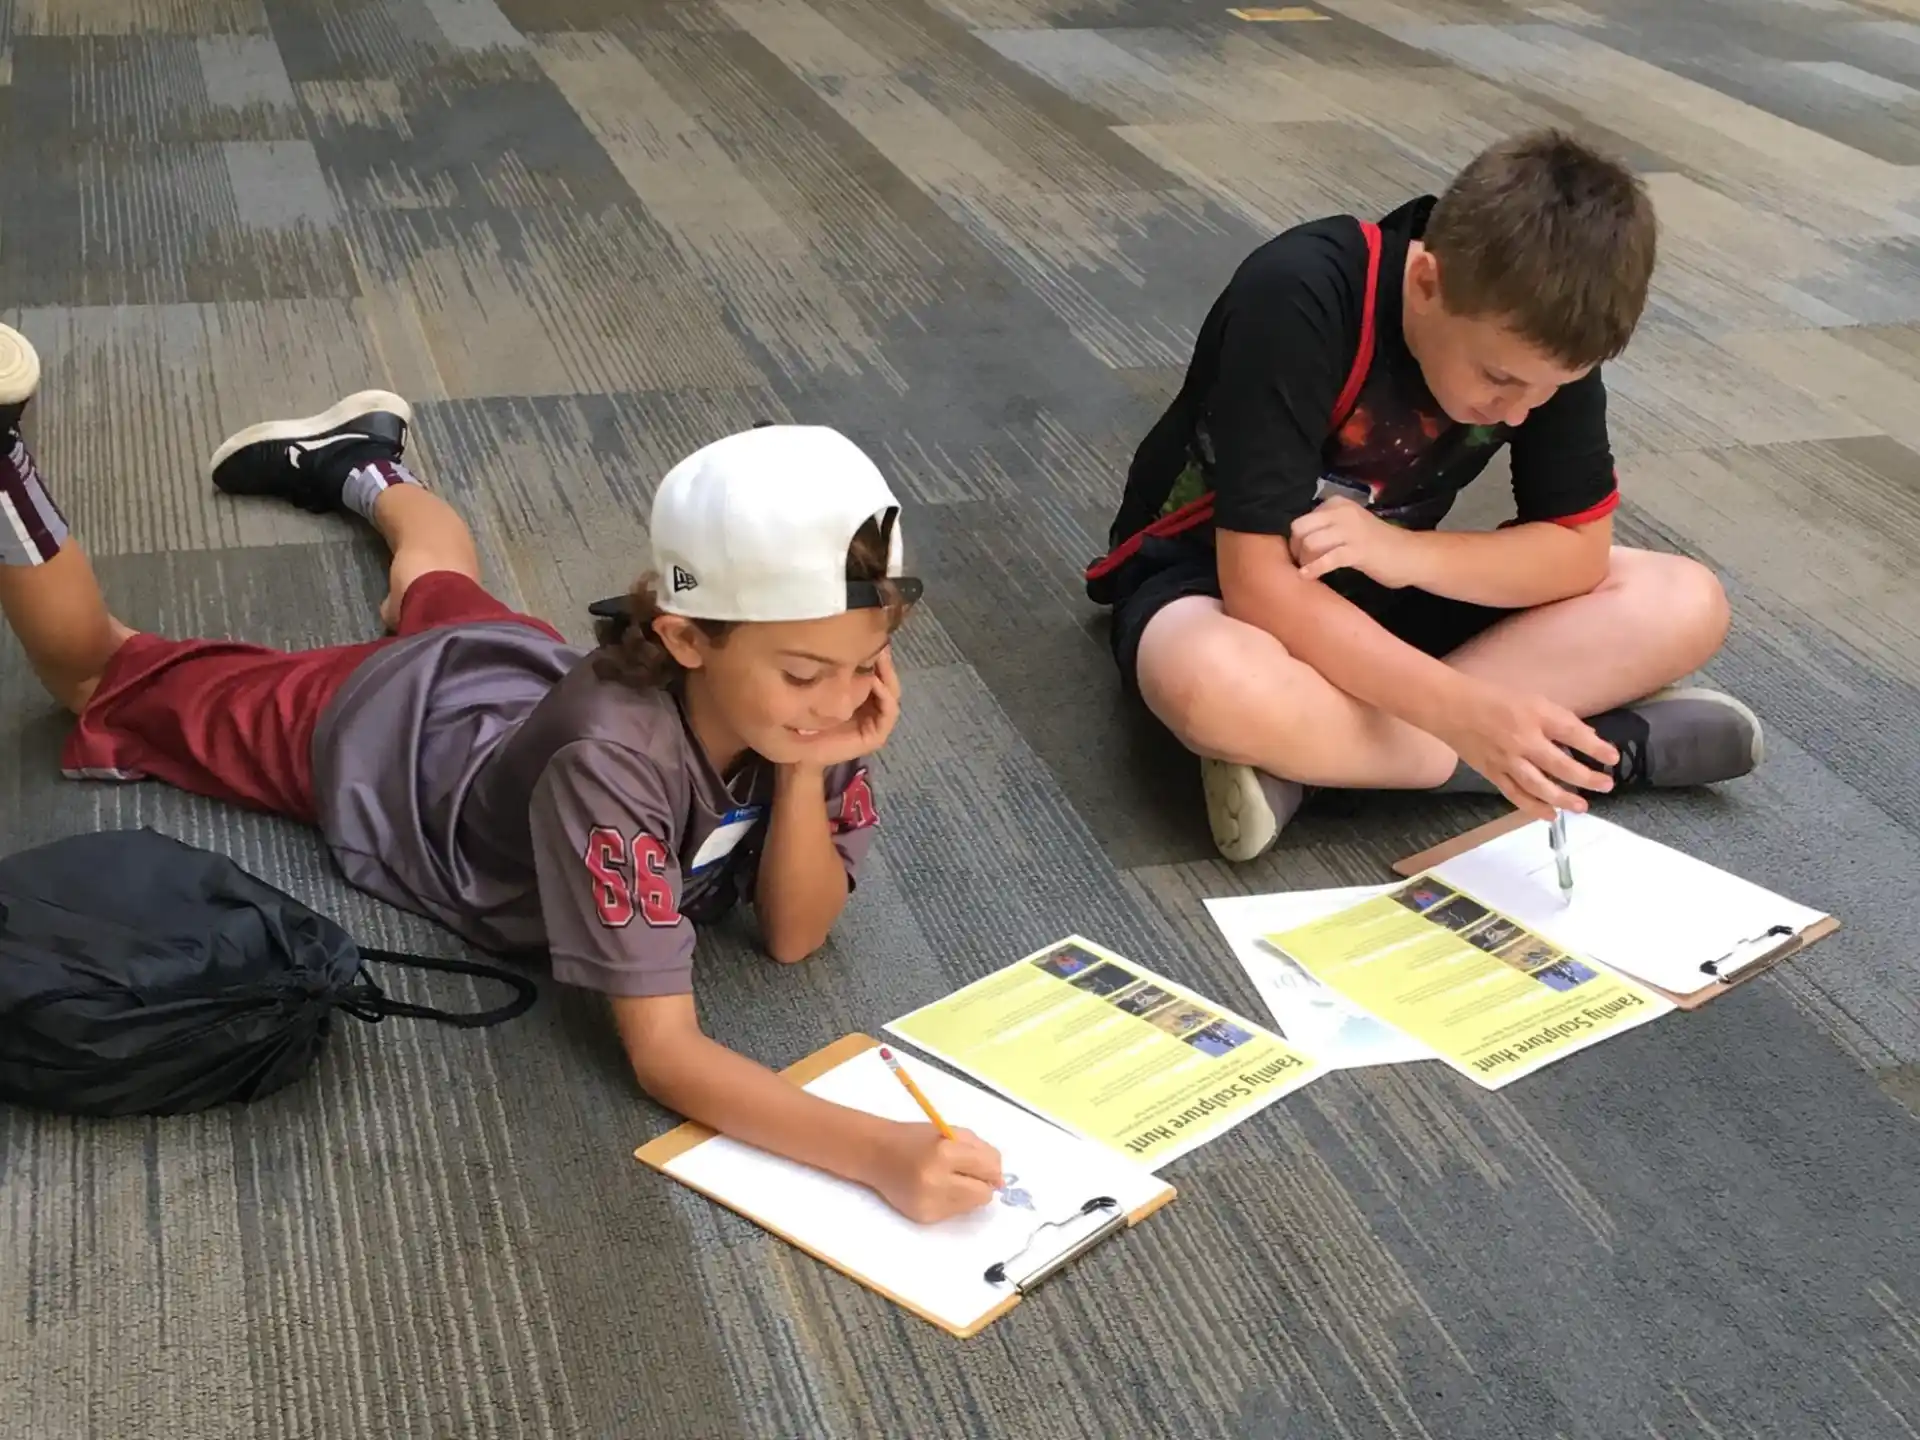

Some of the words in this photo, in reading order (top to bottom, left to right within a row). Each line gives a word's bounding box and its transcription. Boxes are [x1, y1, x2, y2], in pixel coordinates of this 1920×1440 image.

[584, 822, 683, 928] 66
[1582, 993, 1645, 1020] Family
[1512, 1016, 1594, 1054] Sculpture
[1239, 1054, 1303, 1086] Family
[1472, 1047, 1521, 1072] Hunt
[1168, 1083, 1252, 1129] Sculpture
[1124, 1125, 1176, 1153] Hunt
